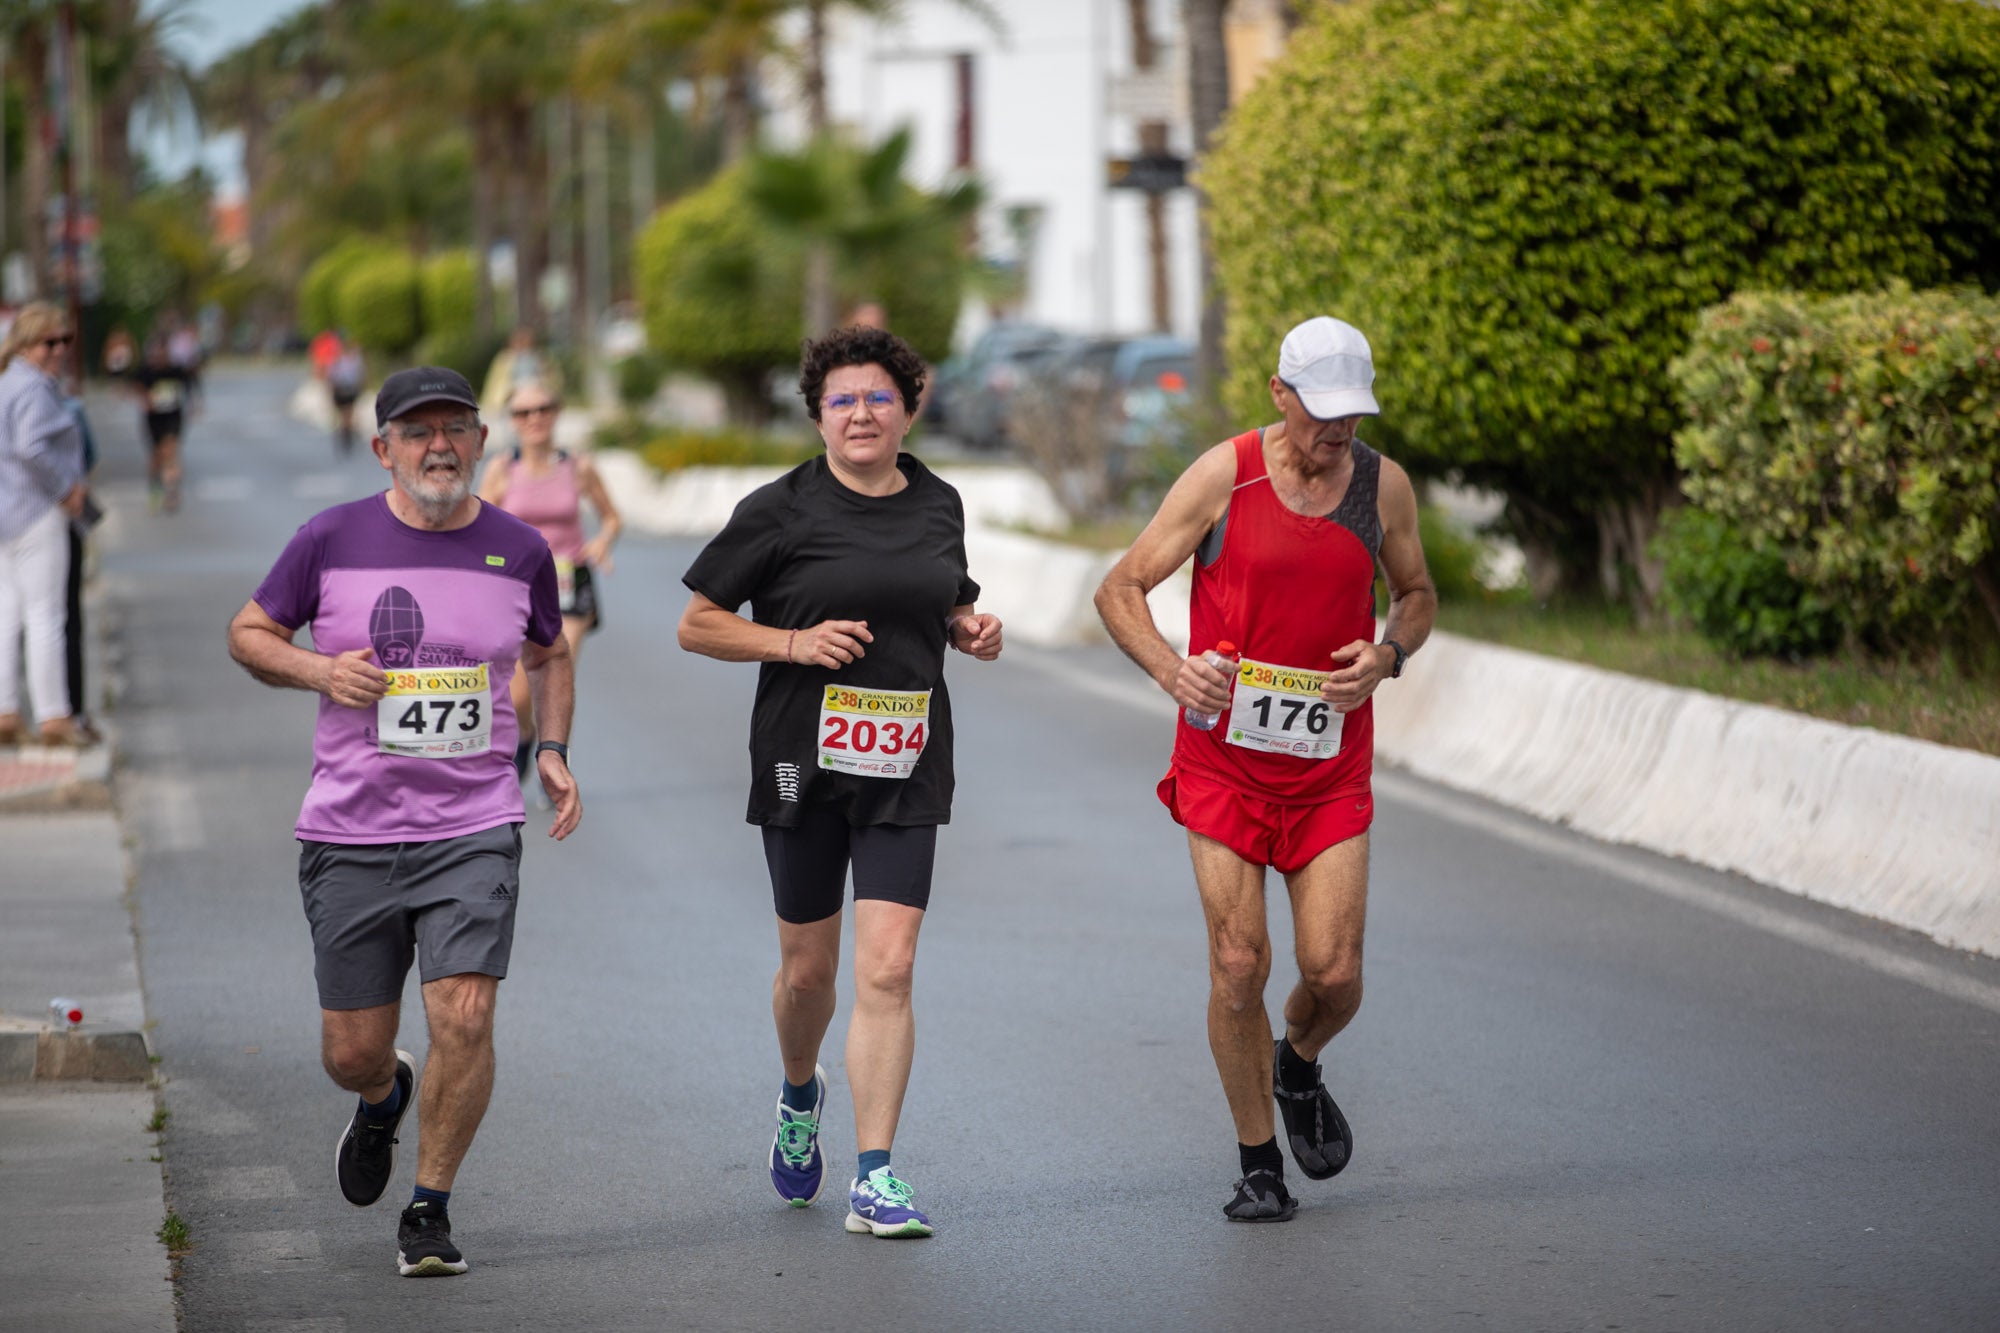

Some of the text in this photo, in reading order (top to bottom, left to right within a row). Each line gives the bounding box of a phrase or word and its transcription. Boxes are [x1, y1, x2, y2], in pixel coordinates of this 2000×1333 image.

[385, 647, 409, 662] 37
[421, 645, 466, 657] NOCHE DE
[418, 652, 441, 666] SAN
[1254, 667, 1273, 684] 38
[1277, 670, 1298, 678] GRAN
[397, 674, 417, 690] 38
[417, 677, 478, 690] FONDO
[839, 691, 858, 707] 38
[858, 698, 914, 712] FONDO
[399, 699, 480, 734] 473
[1252, 695, 1330, 735] 176
[822, 716, 925, 756] 2034
